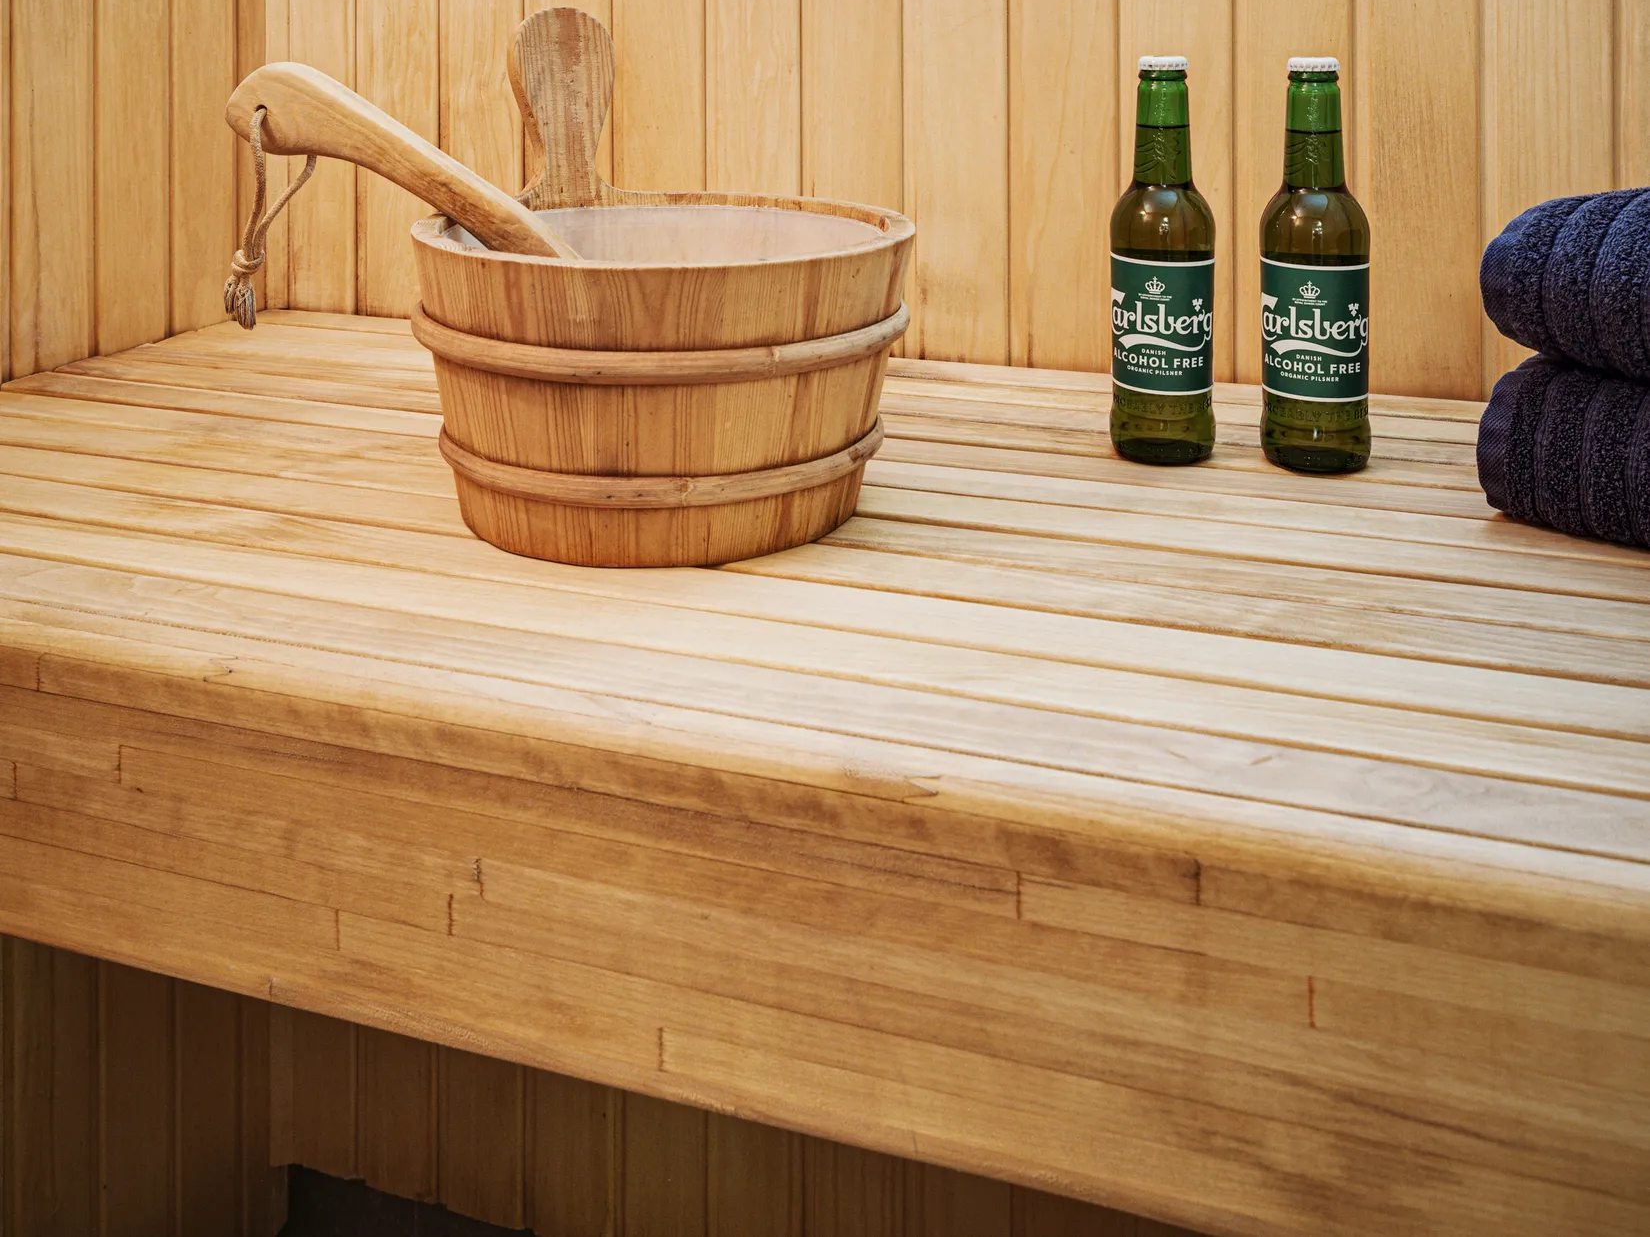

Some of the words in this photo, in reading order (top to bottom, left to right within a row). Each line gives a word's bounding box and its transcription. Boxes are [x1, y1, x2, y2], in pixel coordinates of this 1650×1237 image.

[1141, 348, 1167, 356] DANISH
[1114, 347, 1169, 369] ALCOHOL
[1173, 356, 1204, 369] FREE
[1295, 354, 1322, 362] DANISH
[1264, 353, 1325, 374] ALCOHOL
[1329, 362, 1361, 374] FREE
[1127, 365, 1153, 375] ORGANIC
[1280, 371, 1309, 381] ORGANIC
